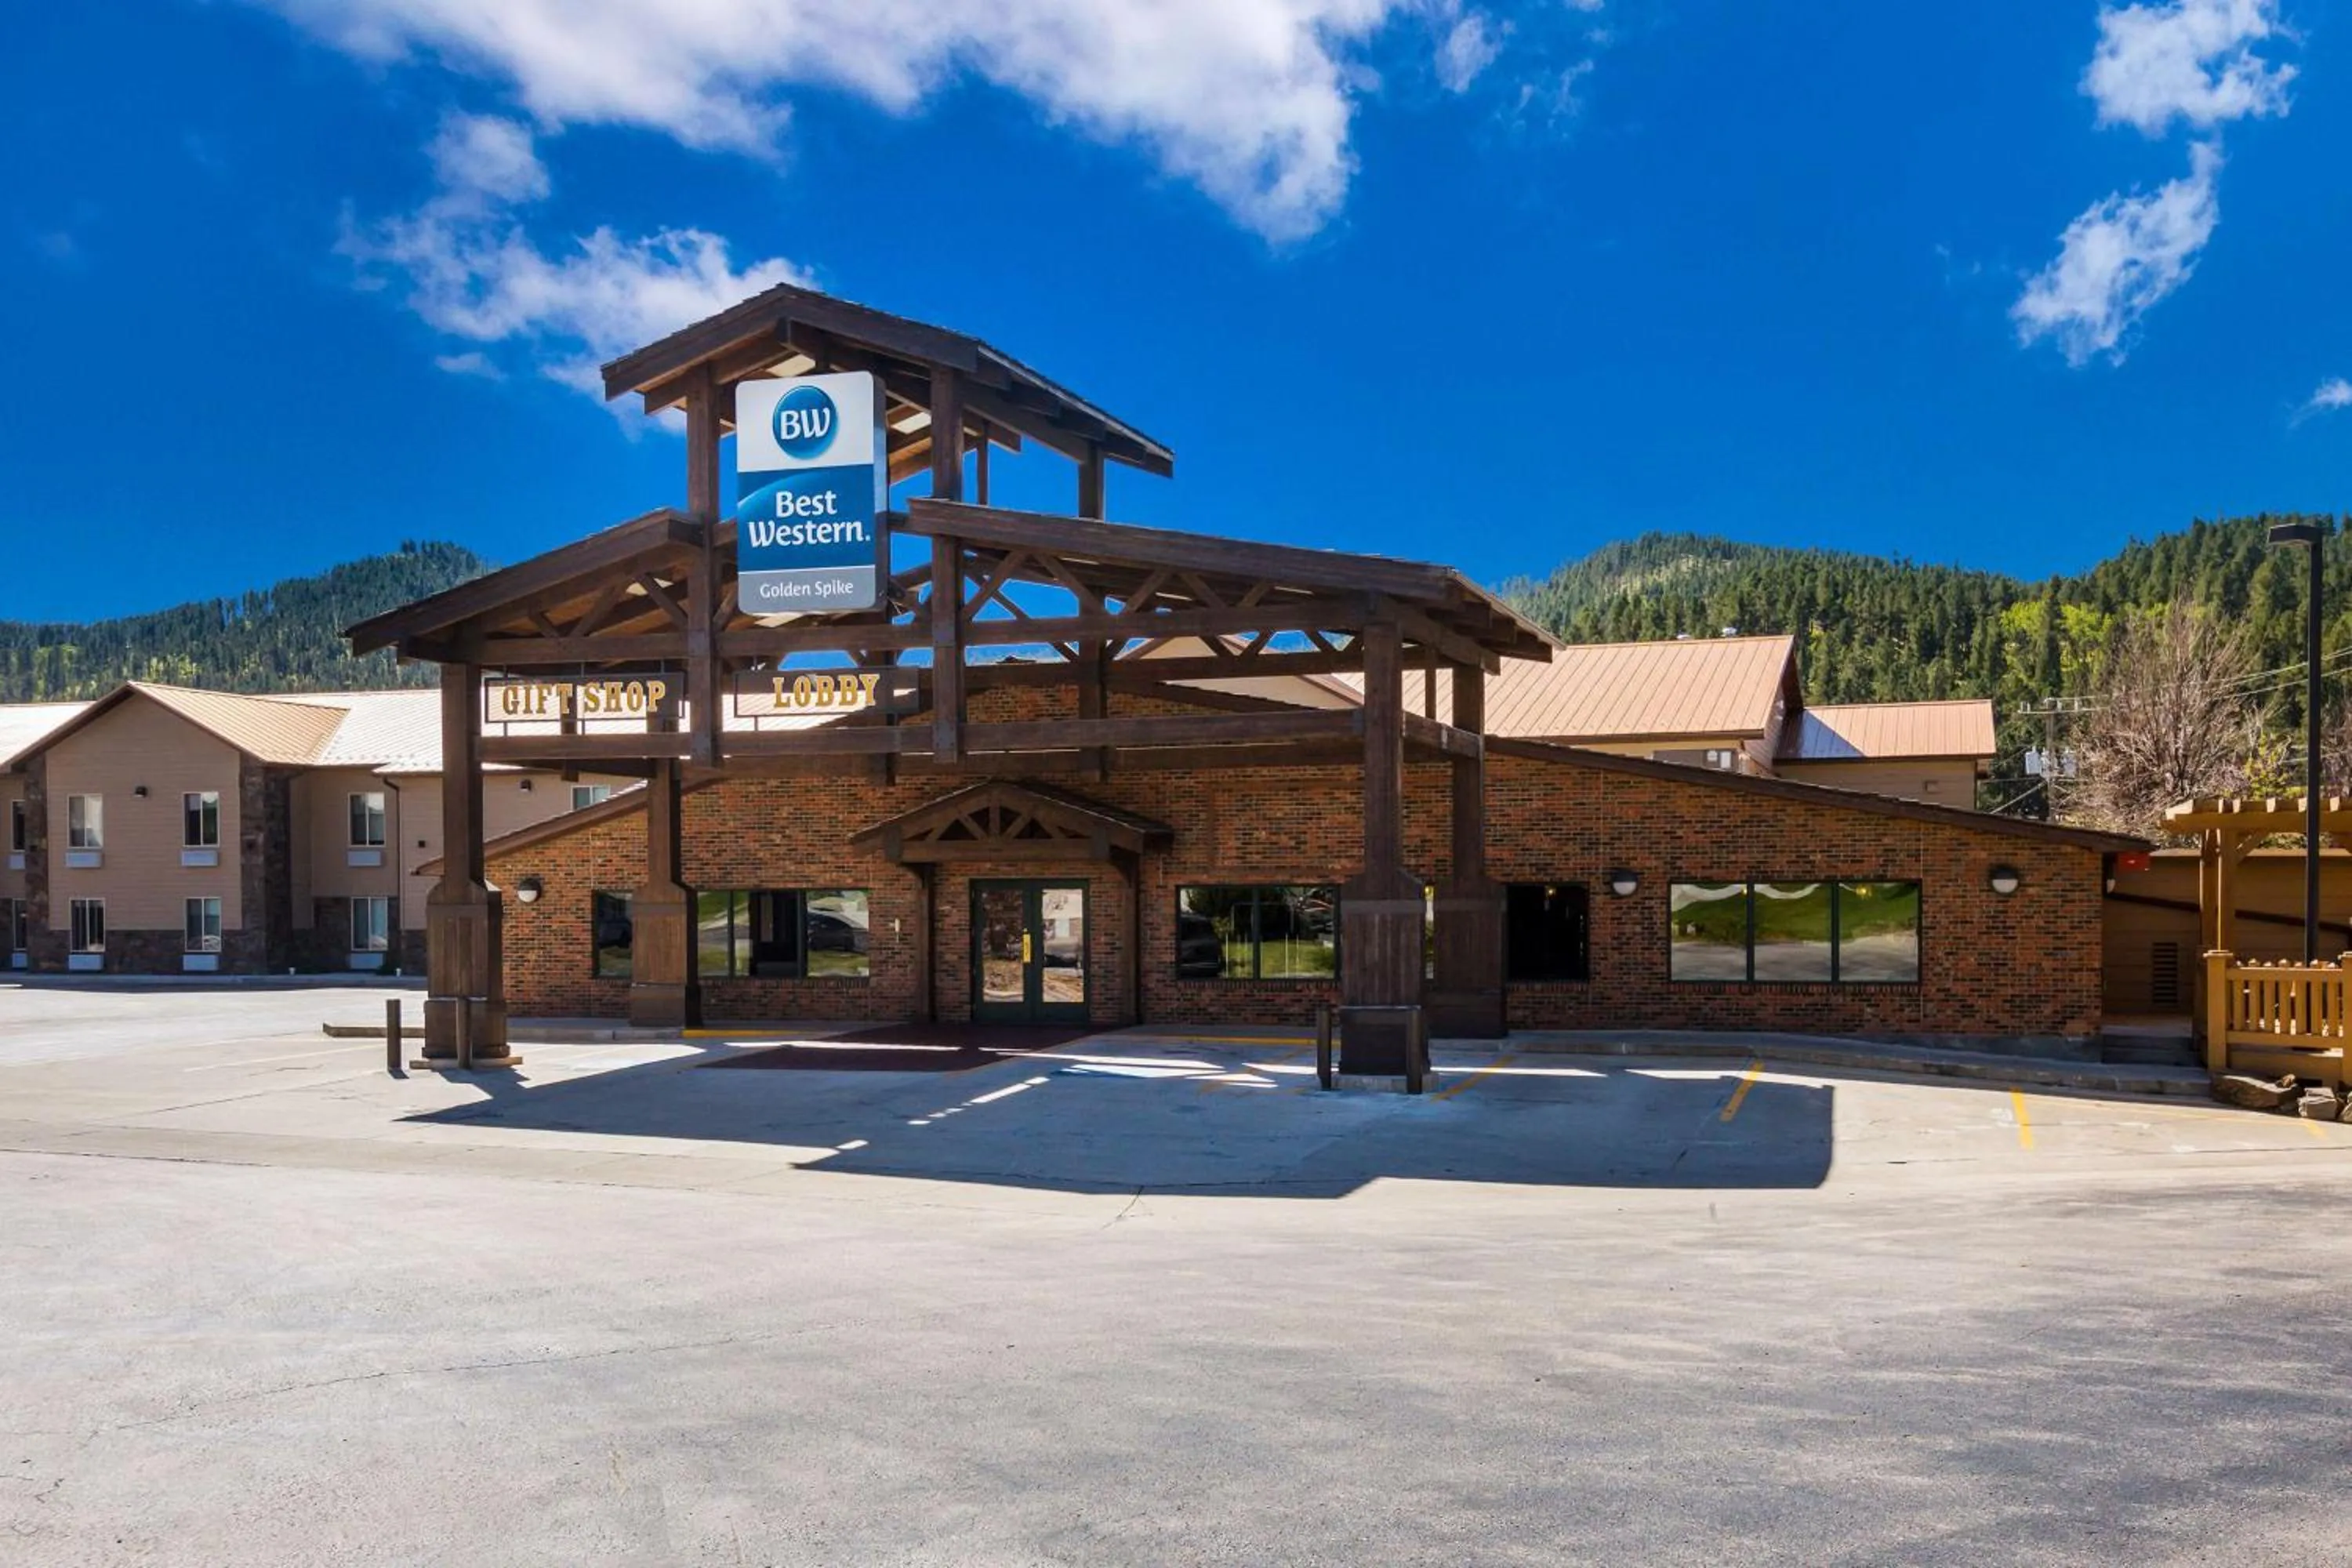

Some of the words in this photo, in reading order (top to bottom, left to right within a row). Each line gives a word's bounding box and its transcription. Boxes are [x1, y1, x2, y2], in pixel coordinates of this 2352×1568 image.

[780, 408, 829, 440] BW
[775, 489, 837, 518] Best
[759, 582, 811, 598] Golden
[815, 579, 854, 597] Spike
[502, 683, 573, 715] GIFT
[583, 681, 666, 713] SHOP
[772, 673, 880, 707] LOBBY
